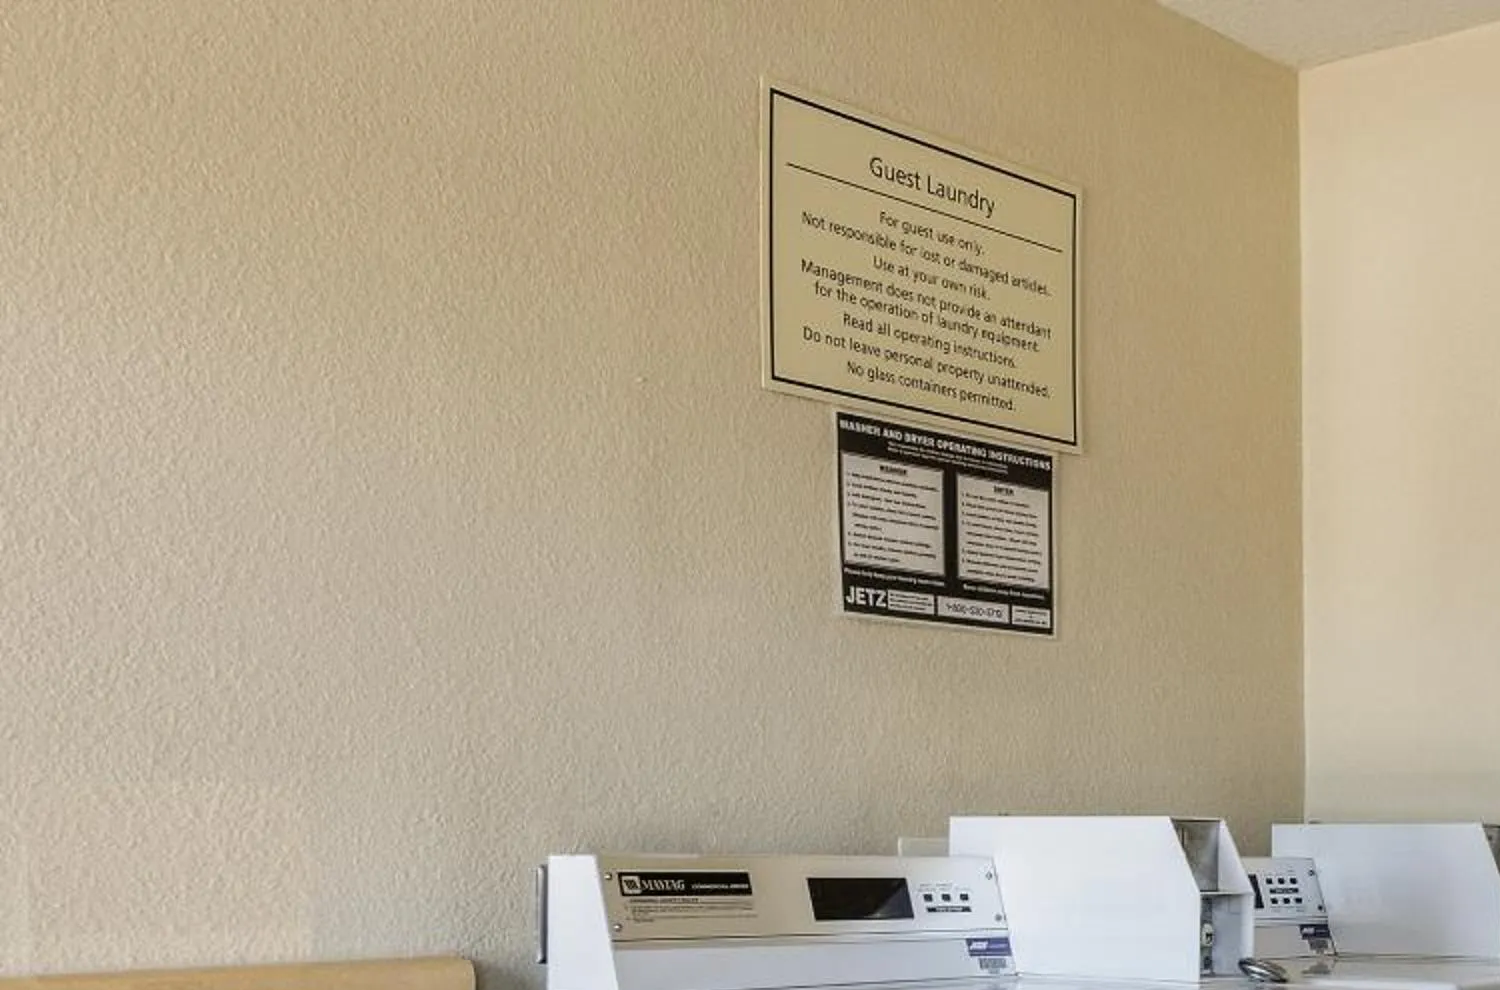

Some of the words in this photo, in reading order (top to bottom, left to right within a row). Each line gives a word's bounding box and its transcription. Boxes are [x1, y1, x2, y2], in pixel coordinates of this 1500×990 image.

[869, 157, 921, 190] Guest
[927, 175, 994, 218] Laundry
[801, 211, 826, 231] Not
[829, 222, 897, 251] responsible
[900, 240, 918, 256] for
[921, 245, 941, 265] lost
[944, 256, 956, 267] or
[959, 259, 1009, 285] damaged
[1011, 274, 1052, 297] articles.
[879, 211, 899, 228] For
[902, 221, 933, 240] guest
[937, 231, 955, 246] use
[957, 238, 985, 256] only.
[801, 258, 883, 294] Management
[886, 283, 914, 302] does
[917, 293, 937, 308] not
[940, 300, 981, 321] provide
[984, 311, 997, 324] an
[1000, 316, 1051, 340] attendant
[873, 255, 895, 273] Use
[898, 265, 909, 277] at
[913, 271, 938, 285] your
[941, 279, 966, 294] own
[969, 284, 990, 301] risk.
[815, 280, 833, 298] for
[837, 288, 857, 305] the
[860, 297, 919, 320] operation
[921, 311, 934, 325] of
[938, 315, 979, 339] laundry
[843, 312, 873, 333] Read
[878, 321, 891, 337] all
[894, 328, 951, 354] operating
[803, 326, 821, 343] Do
[825, 334, 846, 349] not
[849, 338, 881, 357] leave
[884, 348, 933, 370] personal
[937, 360, 985, 384] property
[987, 375, 1051, 400] unattended.
[847, 360, 865, 376] No
[867, 365, 895, 385] glass
[898, 374, 957, 399] containers
[960, 389, 1017, 412] permitted.
[840, 419, 881, 437] WASHER
[882, 428, 903, 441] AND
[936, 439, 987, 458] OPERATING
[988, 449, 1051, 472] INSTRUCTIONS
[846, 585, 887, 608] JETZ
[640, 879, 685, 892] MAYTAG
